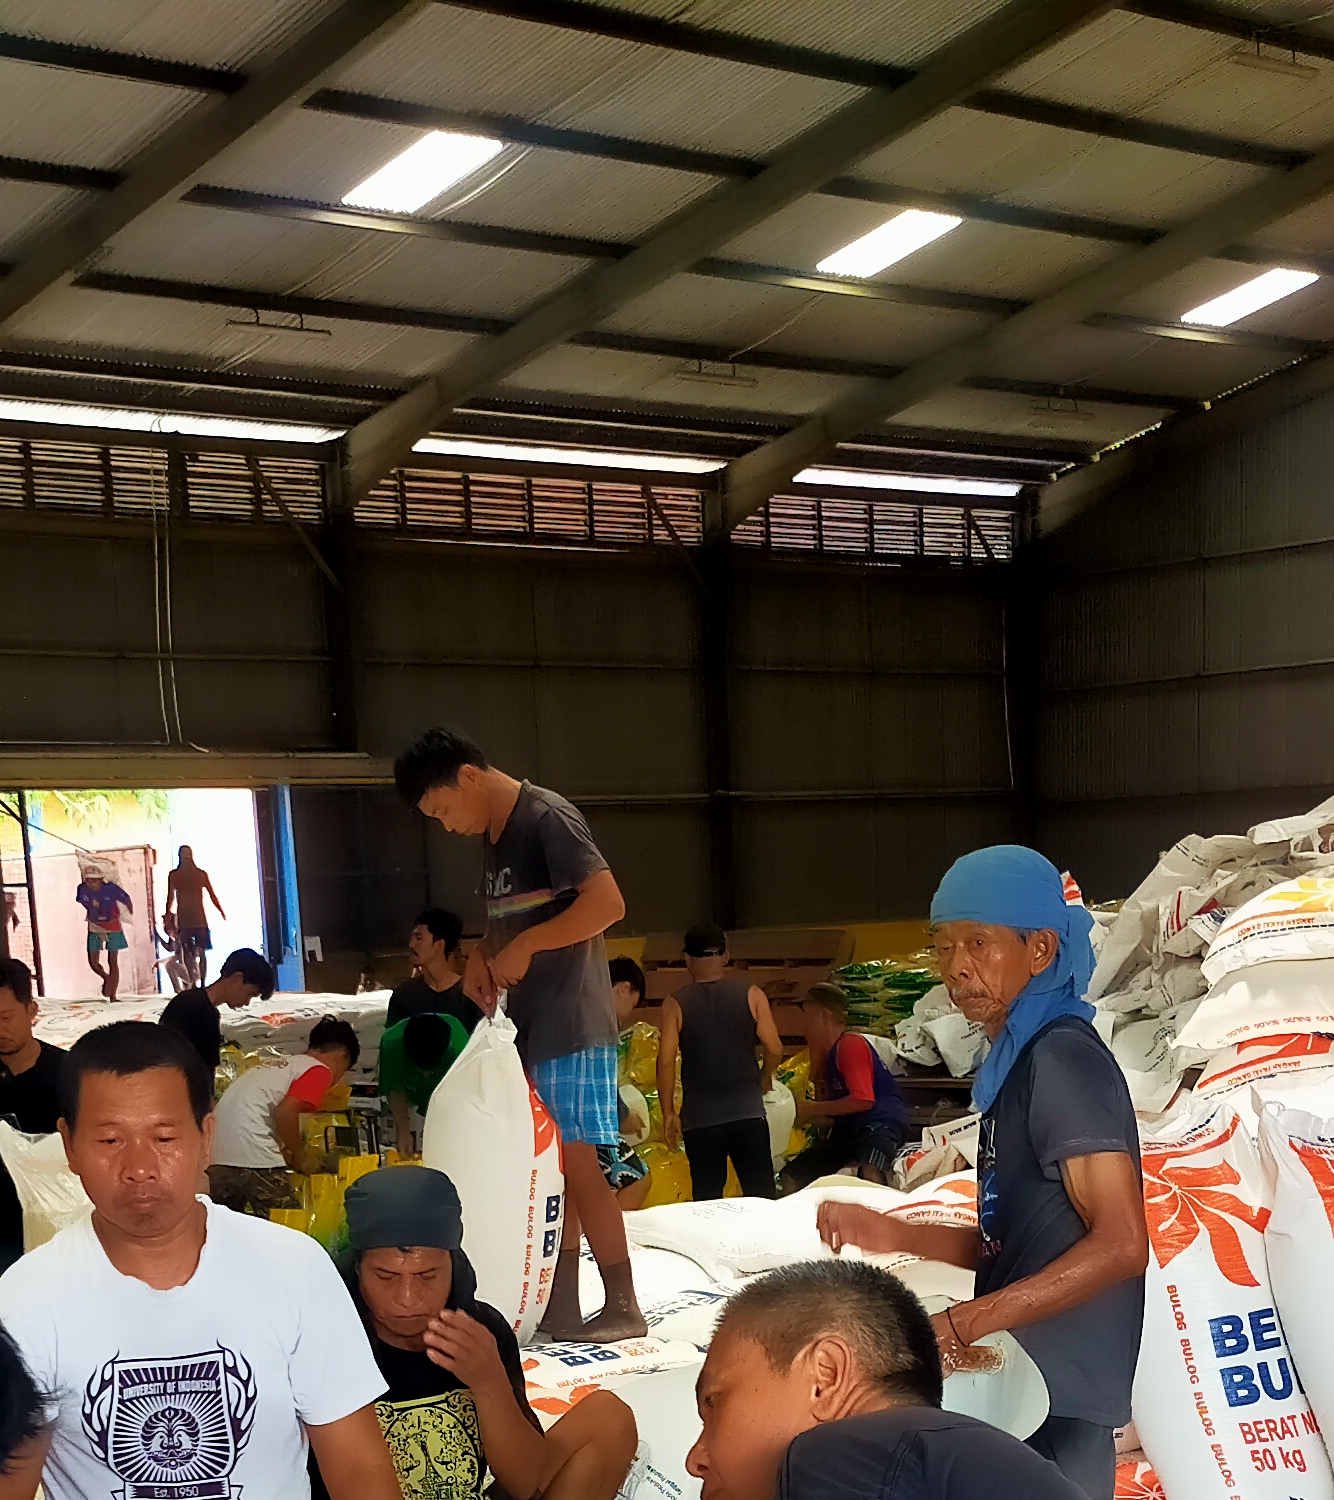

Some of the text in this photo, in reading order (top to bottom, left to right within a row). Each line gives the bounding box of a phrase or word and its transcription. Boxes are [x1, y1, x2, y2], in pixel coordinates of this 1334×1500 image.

[528, 1169, 538, 1201] BULOG
[526, 1205, 534, 1239] BULOG
[523, 1244, 533, 1276] BULOG
[518, 1281, 530, 1315] BULOG
[1166, 1284, 1188, 1331] BULOG
[1179, 1338, 1200, 1385] BULOG
[122, 1380, 217, 1400] UNIVERSITY OF INDONESIA
[1193, 1391, 1216, 1437] BULOG
[1238, 1414, 1298, 1445] BERAT
[1210, 1443, 1236, 1488] BULOG
[1250, 1447, 1307, 1472] 50 kg
[173, 1485, 199, 1497] 1950
